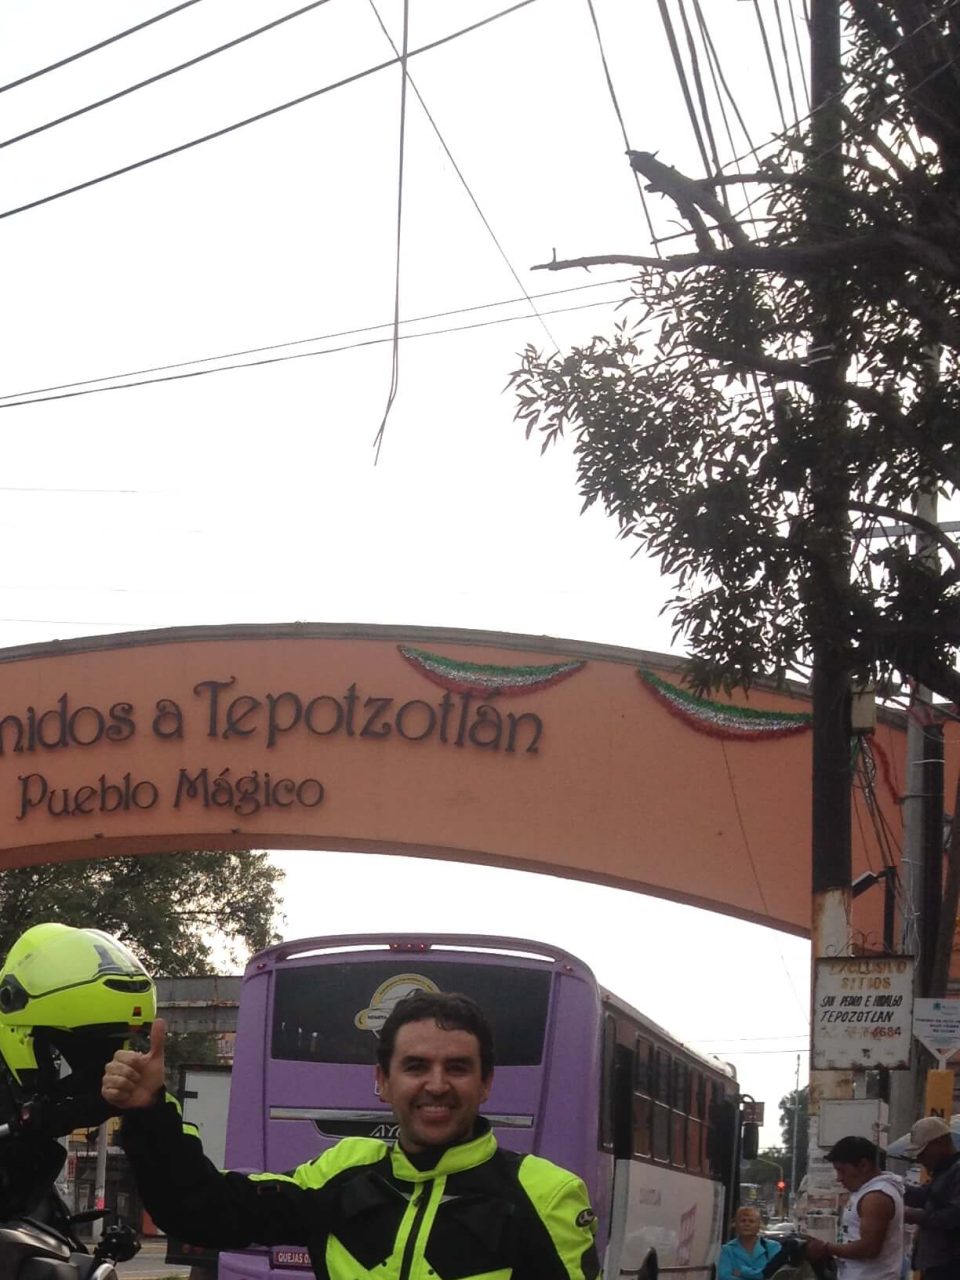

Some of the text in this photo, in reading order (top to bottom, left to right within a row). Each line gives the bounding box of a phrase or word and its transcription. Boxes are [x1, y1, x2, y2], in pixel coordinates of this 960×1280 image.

[152, 699, 184, 739] a
[16, 767, 325, 821] Pueblo Mágico
[820, 1011, 895, 1023] TEPOZOTLAN
[278, 1252, 303, 1263] QUEJAS
